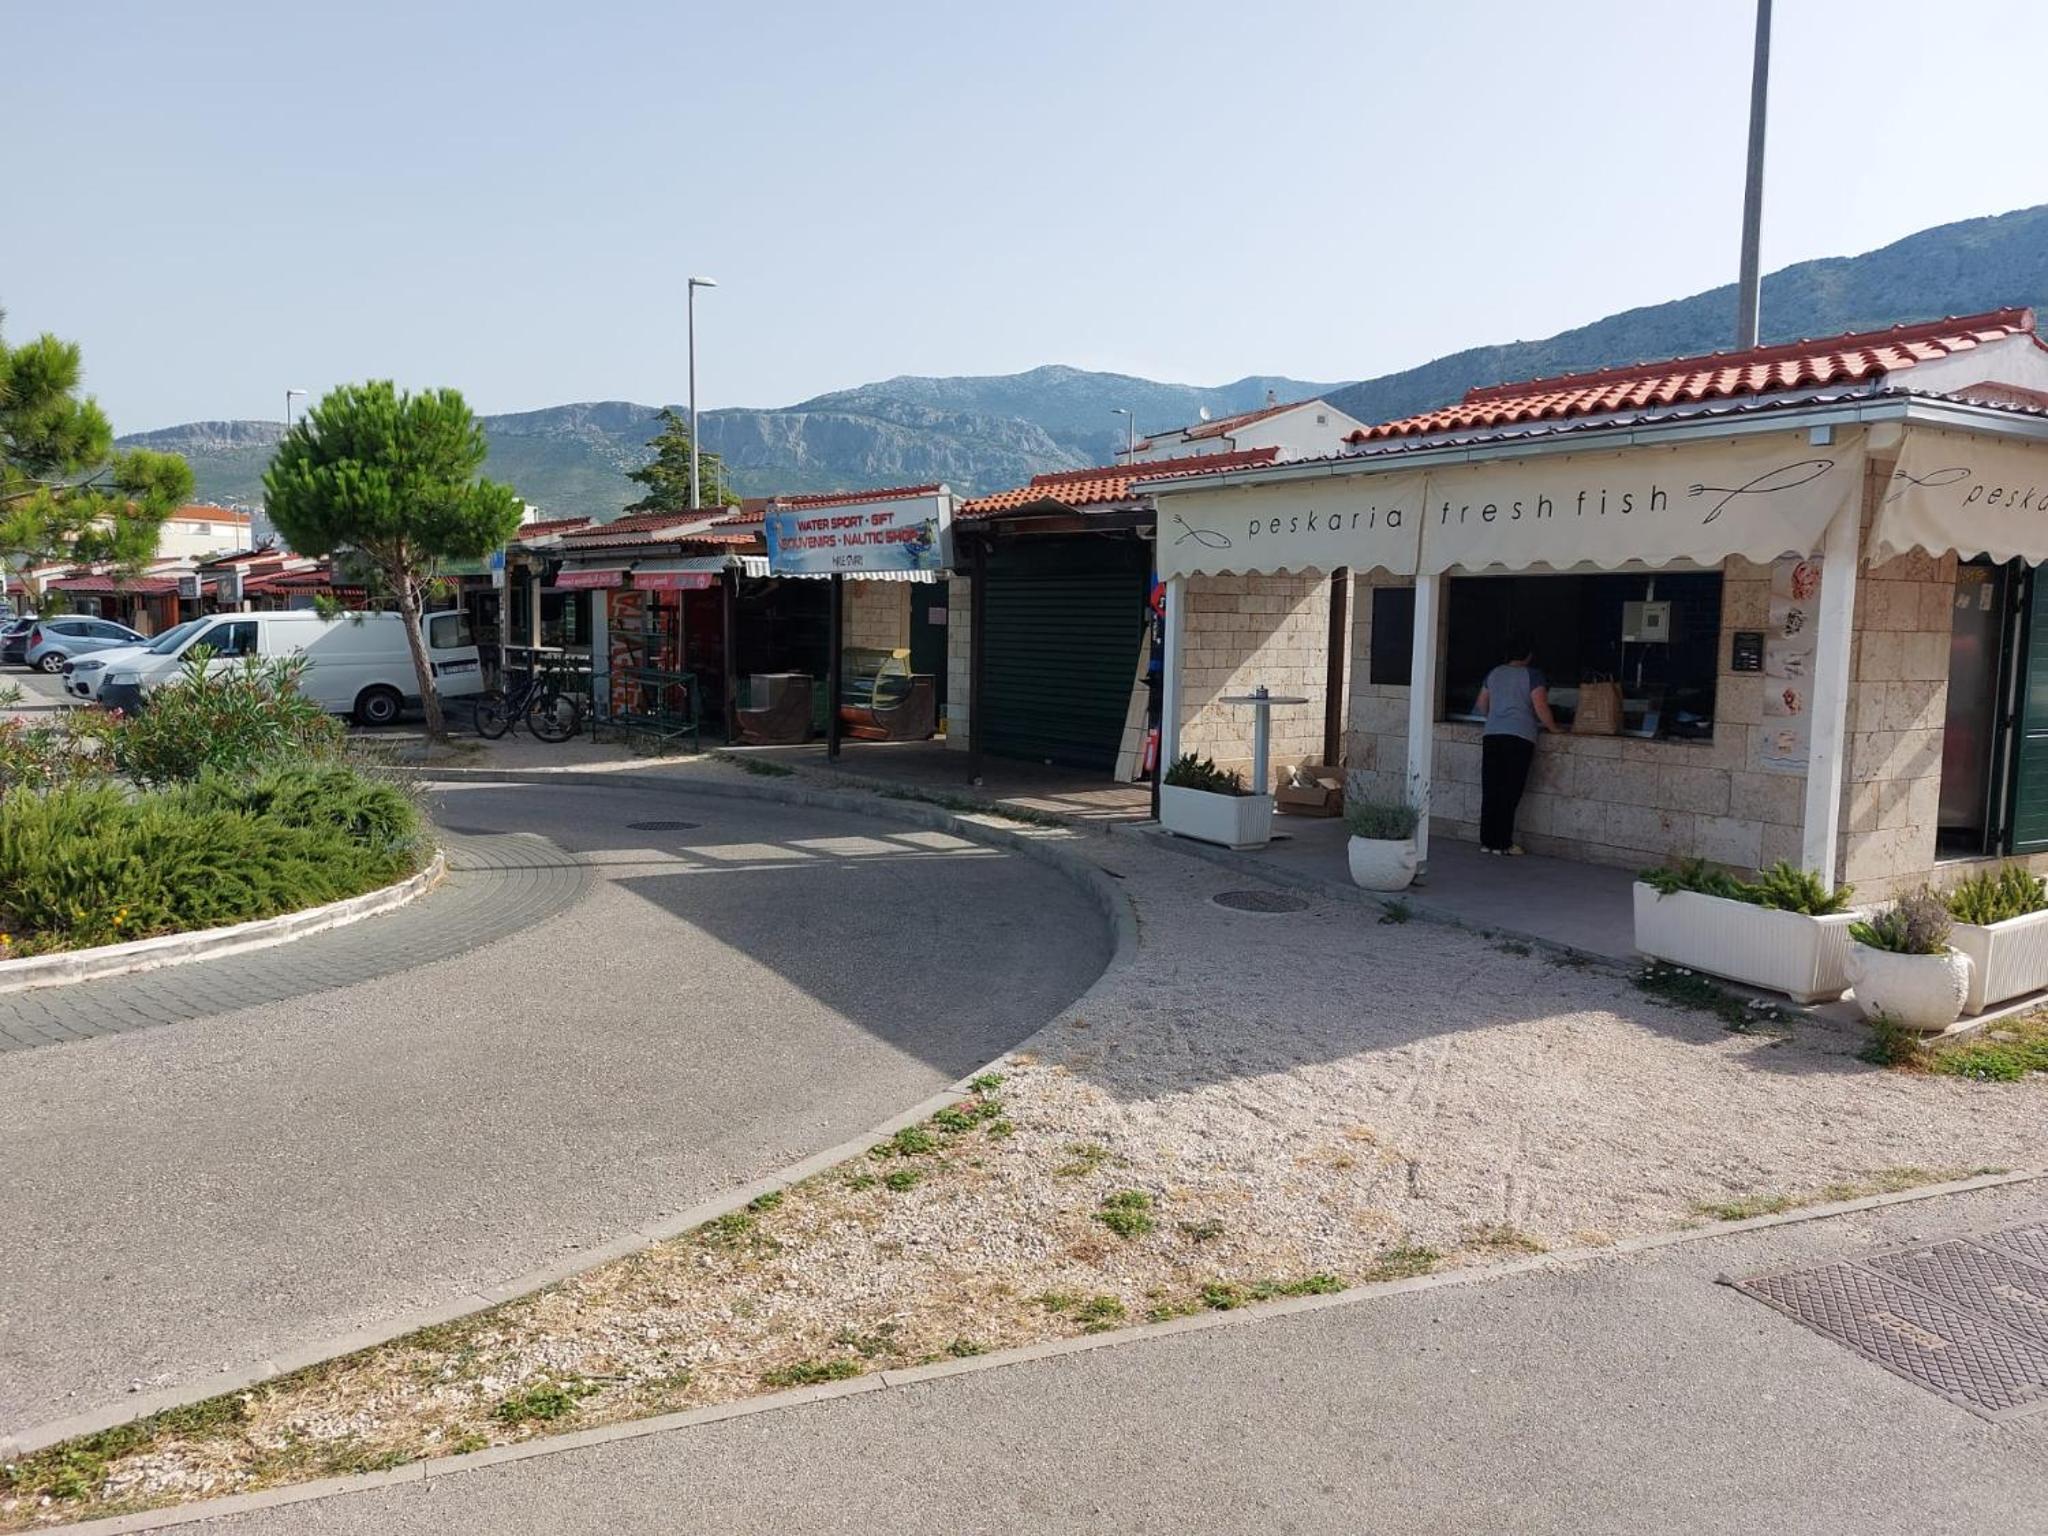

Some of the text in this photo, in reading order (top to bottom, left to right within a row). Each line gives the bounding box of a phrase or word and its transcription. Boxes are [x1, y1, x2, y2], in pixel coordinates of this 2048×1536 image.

[1440, 484, 1668, 525] fresh fish
[797, 511, 895, 532] WATER SPORT GIFT
[1248, 506, 1402, 541] peskaria
[778, 527, 918, 551] SOUVENIRS NAUTIC SHOP
